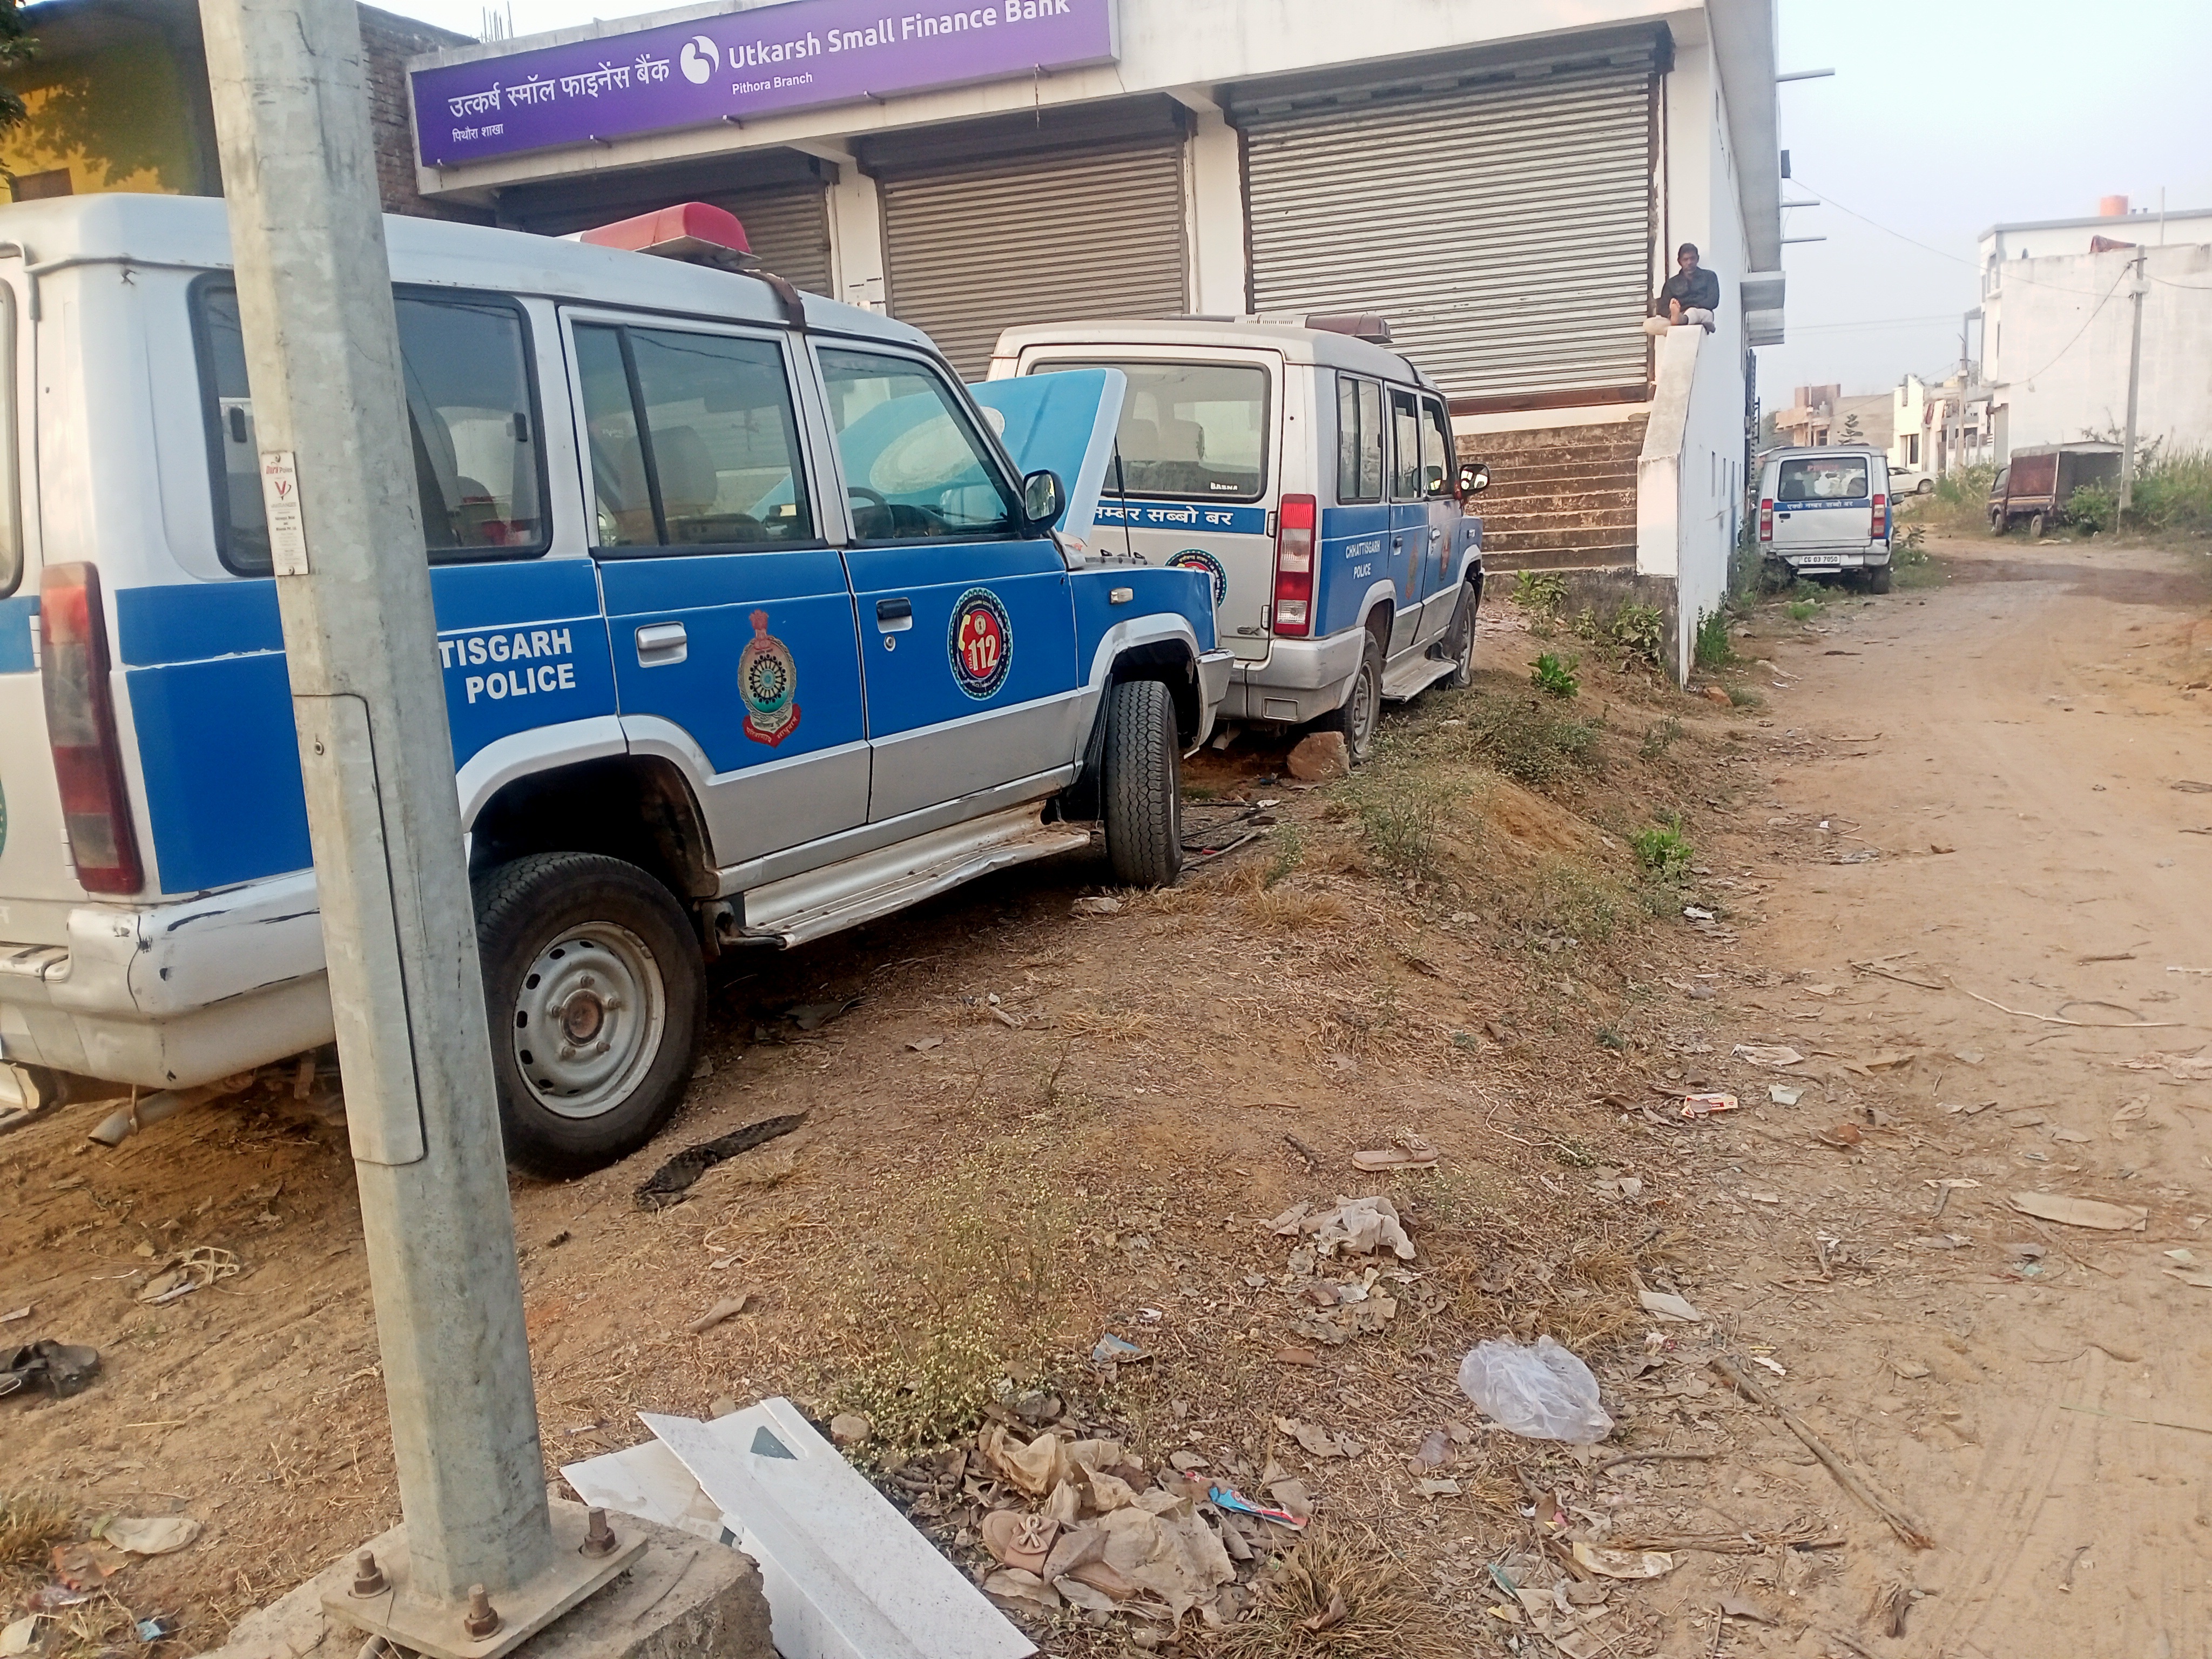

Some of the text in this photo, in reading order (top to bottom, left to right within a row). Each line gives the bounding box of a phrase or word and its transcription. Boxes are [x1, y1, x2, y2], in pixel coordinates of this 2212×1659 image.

[729, 0, 1070, 69] Utkarsh Small Finance Bank
[448, 53, 670, 117] उत्कर्ष स्मॉल फाइनेंस बैंक
[732, 71, 813, 95] Pithora Branch
[451, 123, 504, 142] पिथौरा शाखा
[1146, 505, 1199, 523] सब्बो
[1204, 511, 1234, 525] बर
[1346, 539, 1381, 559] CHHATTISGARH
[1353, 562, 1371, 579] POLICE
[968, 634, 997, 671] 112
[466, 663, 576, 704] POLICE
